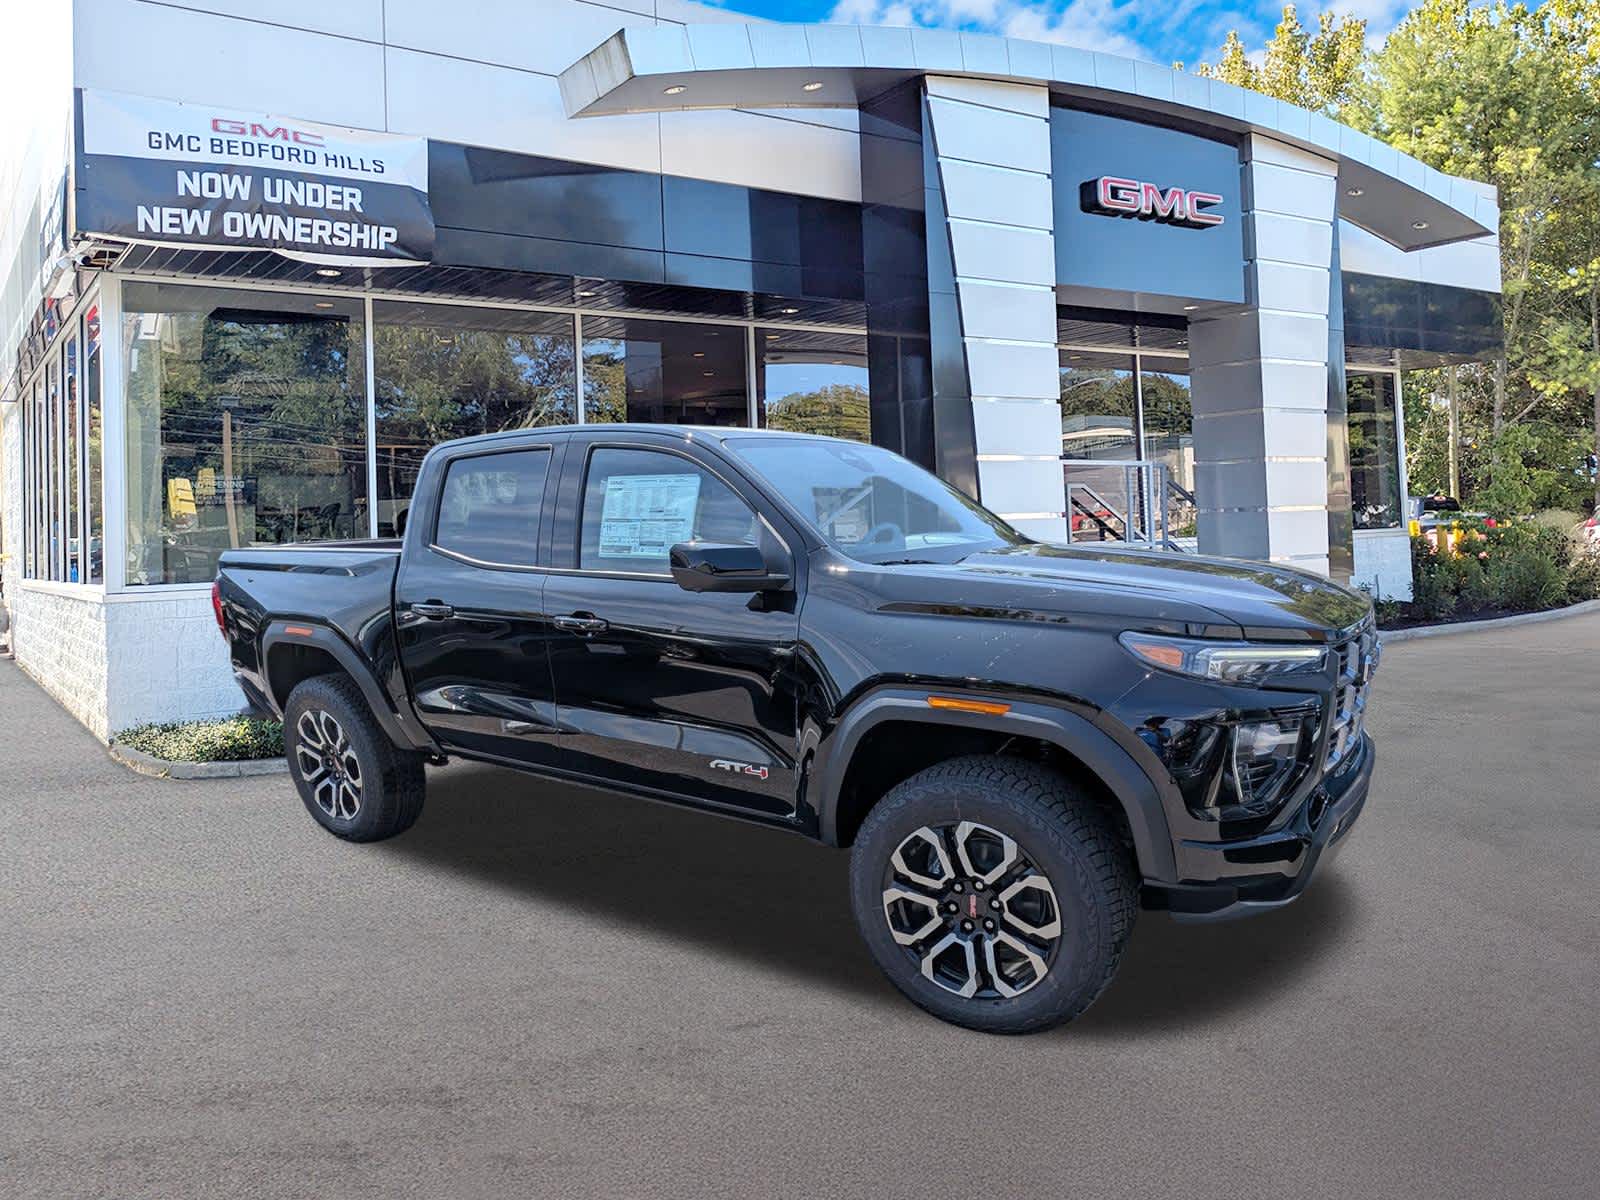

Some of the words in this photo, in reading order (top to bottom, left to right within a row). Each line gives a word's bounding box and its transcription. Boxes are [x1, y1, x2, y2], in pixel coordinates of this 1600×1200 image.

[148, 131, 201, 152] GMC
[211, 138, 316, 165] BEDFORD
[325, 153, 385, 174] HILLS
[211, 117, 326, 148] GMC
[177, 170, 252, 201] NOW
[263, 177, 364, 213] UNDER
[1097, 175, 1225, 225] GMC
[136, 205, 212, 236] NEW
[223, 211, 398, 250] OWNERSHIP
[709, 759, 769, 781] AT4
